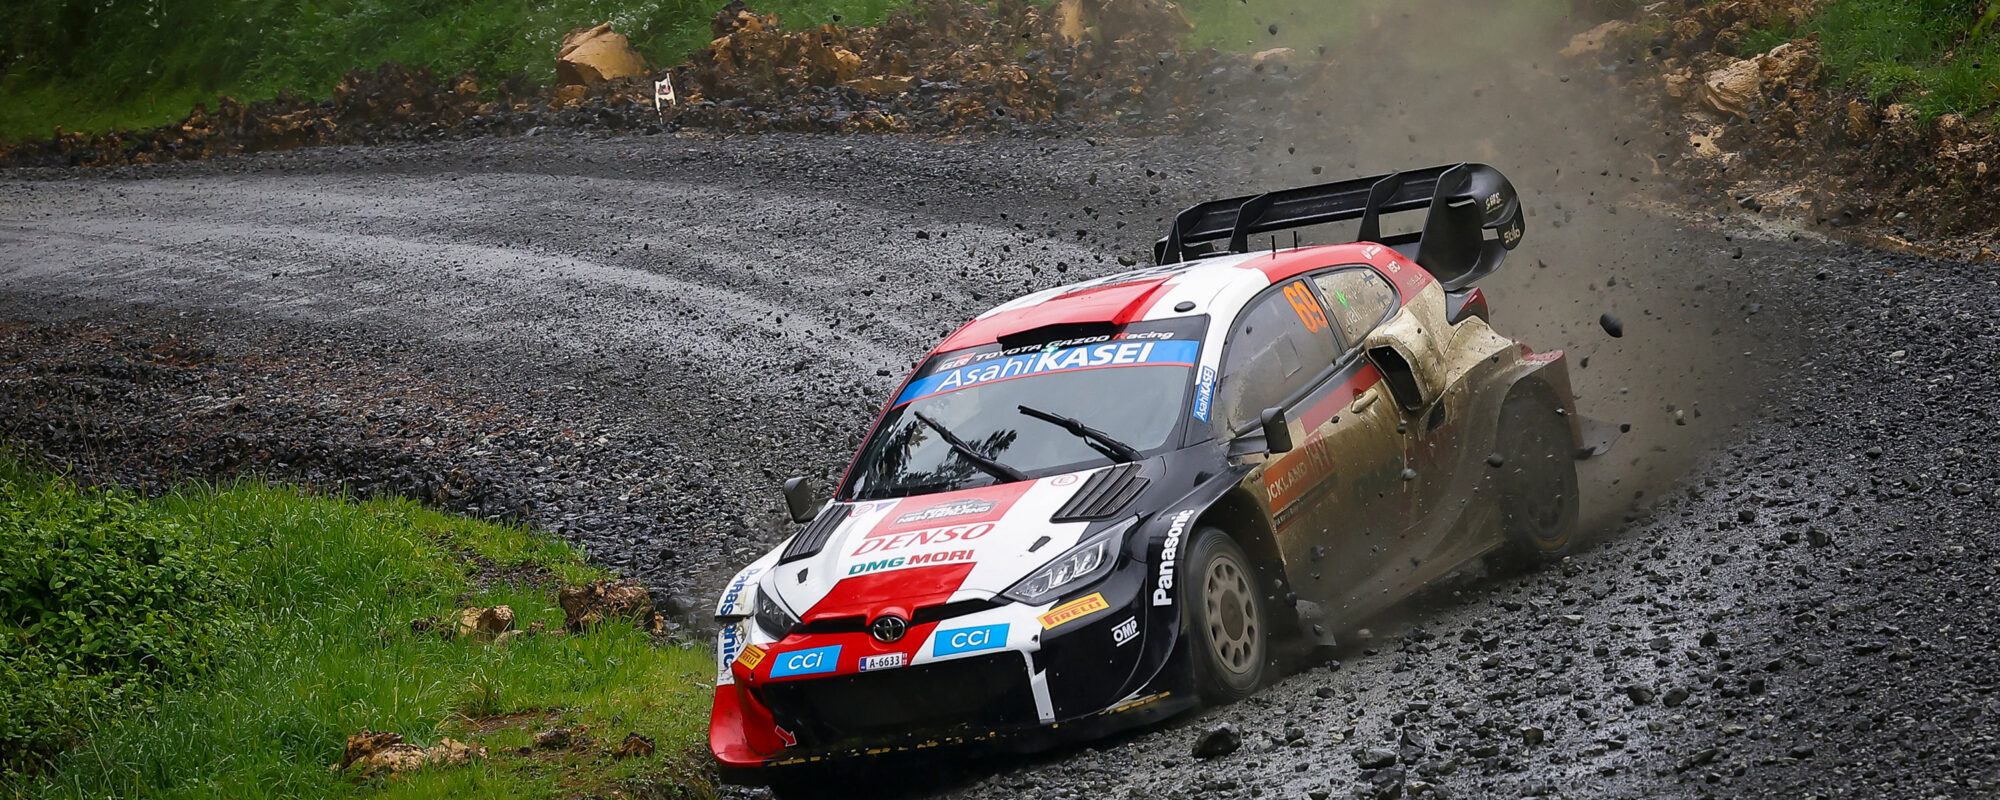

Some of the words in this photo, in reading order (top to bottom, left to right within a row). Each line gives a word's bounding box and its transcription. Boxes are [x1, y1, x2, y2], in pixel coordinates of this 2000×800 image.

[1283, 281, 1328, 334] 69
[974, 343, 1042, 360] TOYOTA
[1045, 334, 1110, 349] GAZOO
[1112, 331, 1175, 340] Racing
[936, 342, 1155, 392] AsahiKASEI
[851, 524, 995, 556] DENSO
[849, 557, 905, 575] DMG
[907, 549, 975, 565] MORI
[1153, 509, 1194, 606] Panasonic
[1044, 596, 1102, 625] PIRELLI
[1113, 620, 1138, 642] OMP
[869, 655, 900, 668] A-6633
